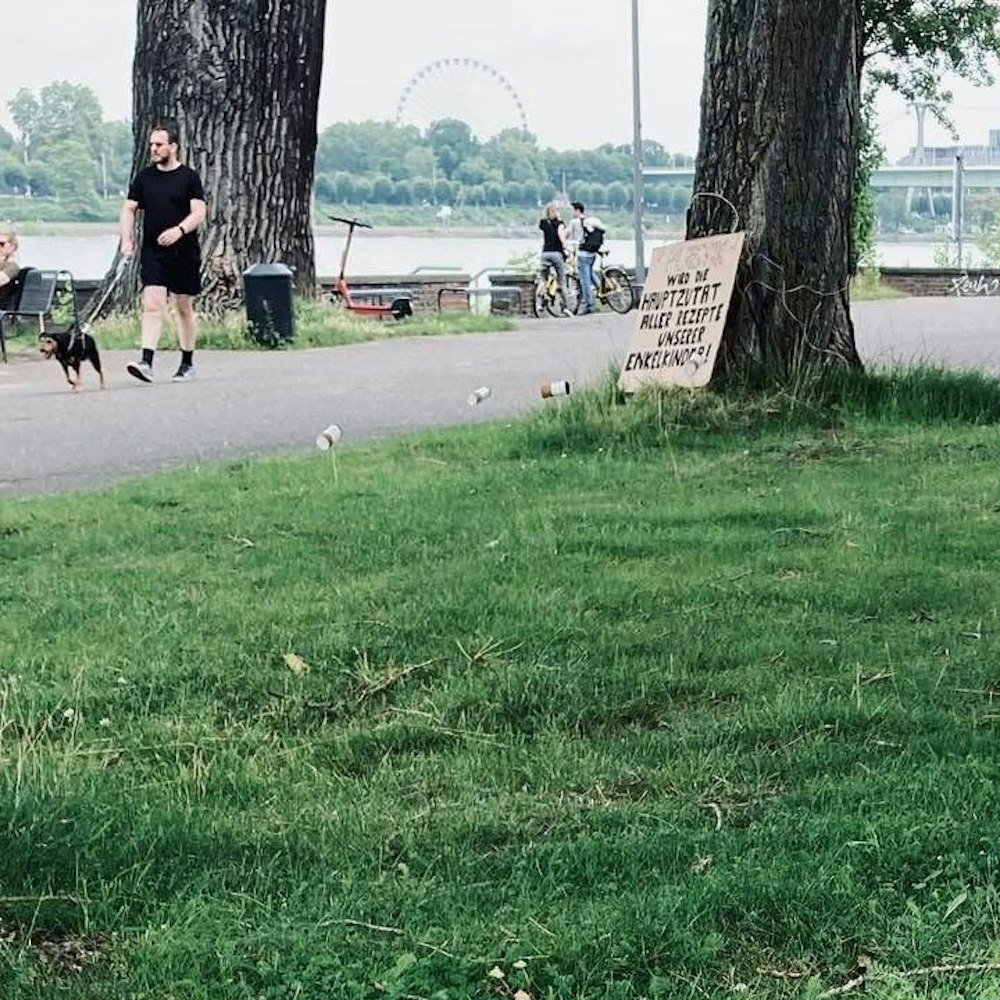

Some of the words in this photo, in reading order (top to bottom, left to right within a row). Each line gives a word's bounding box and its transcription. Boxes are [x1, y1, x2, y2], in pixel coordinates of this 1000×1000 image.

[695, 268, 709, 282] DIE
[641, 282, 722, 311] HAUPTZUTAT
[640, 312, 671, 330] ALLER
[675, 303, 724, 327] REZEPTE
[657, 326, 706, 347] UNSERER
